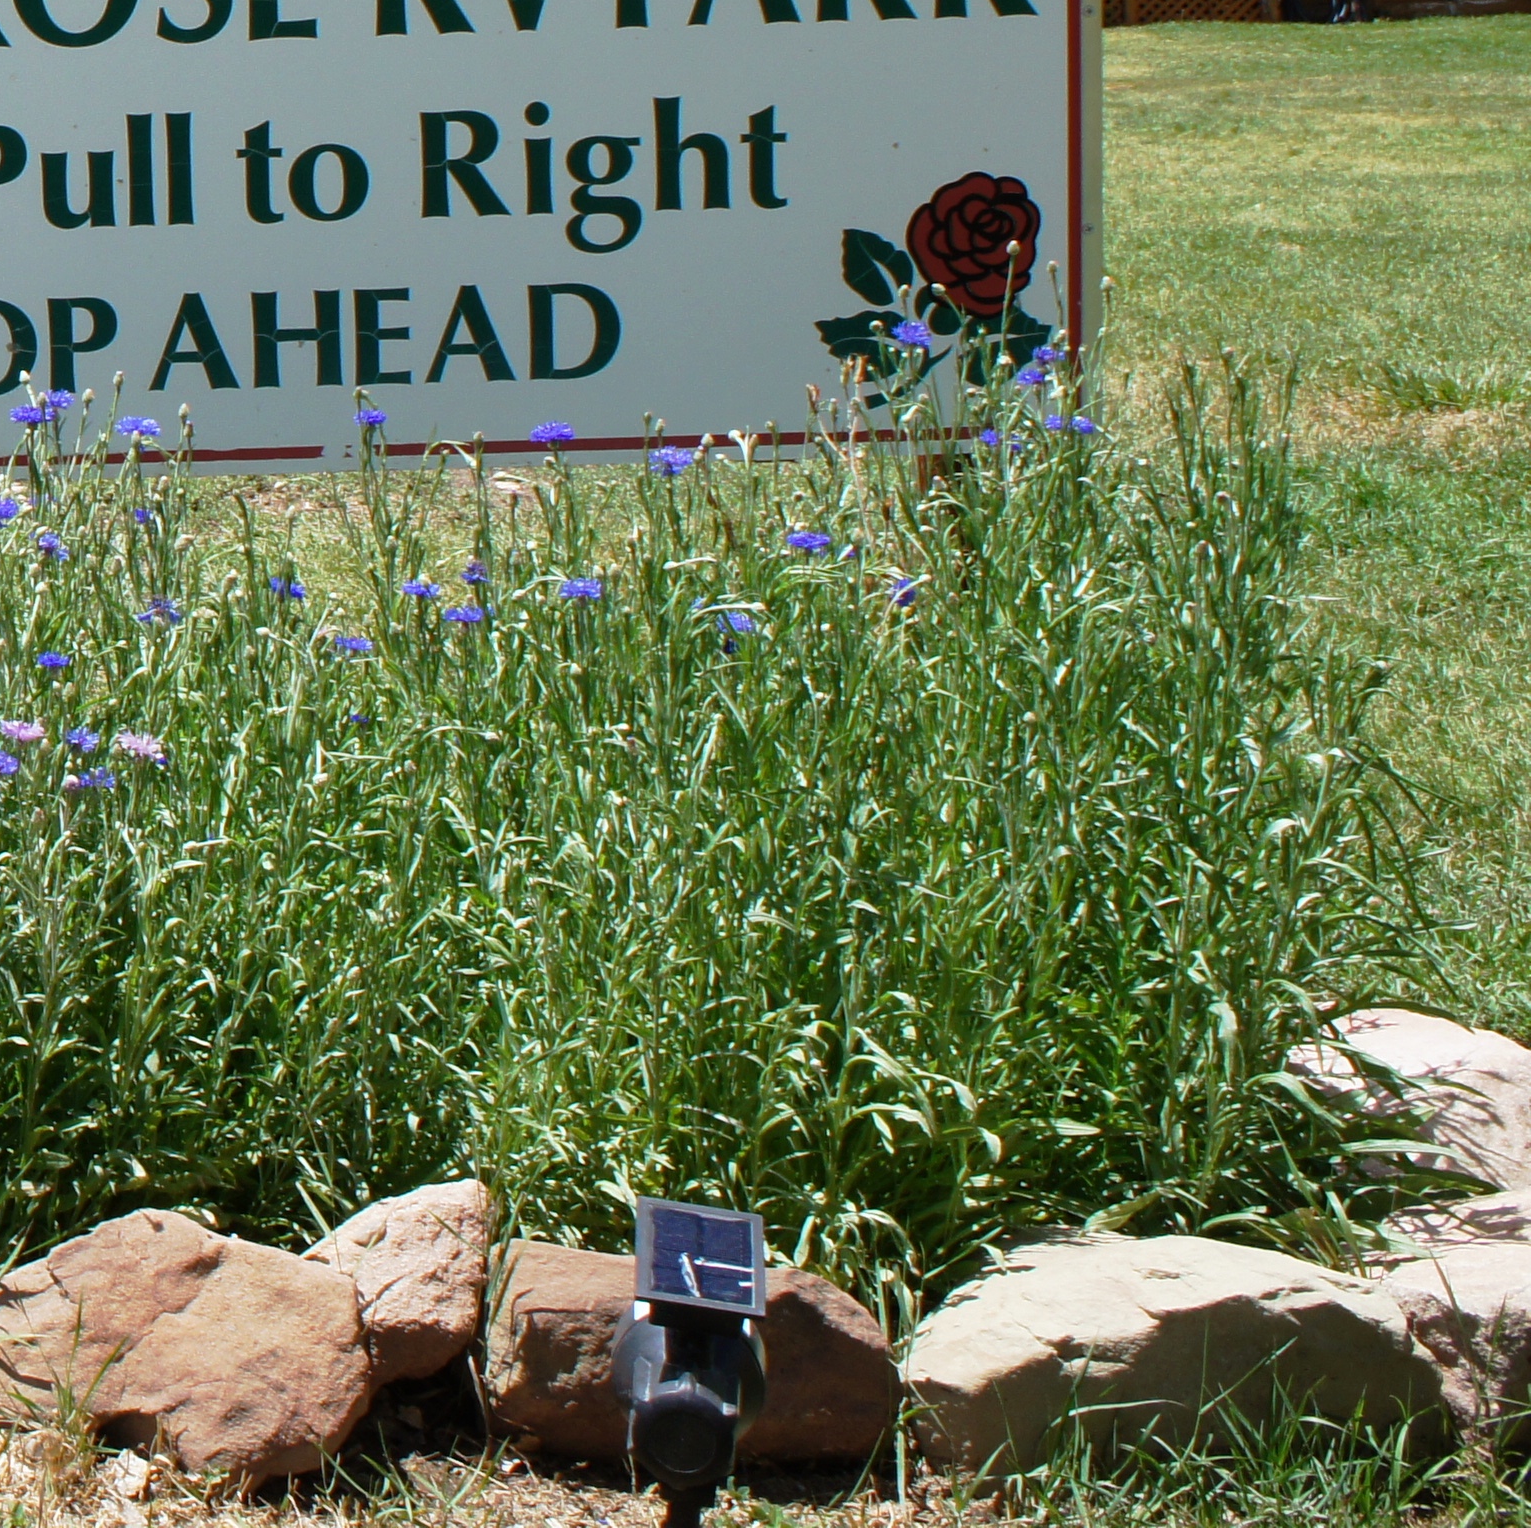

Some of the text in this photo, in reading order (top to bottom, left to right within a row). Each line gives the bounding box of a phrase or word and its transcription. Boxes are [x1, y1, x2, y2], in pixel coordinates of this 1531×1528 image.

[236, 119, 371, 225] to
[419, 95, 789, 255] Right
[148, 282, 623, 392] AHEAD
